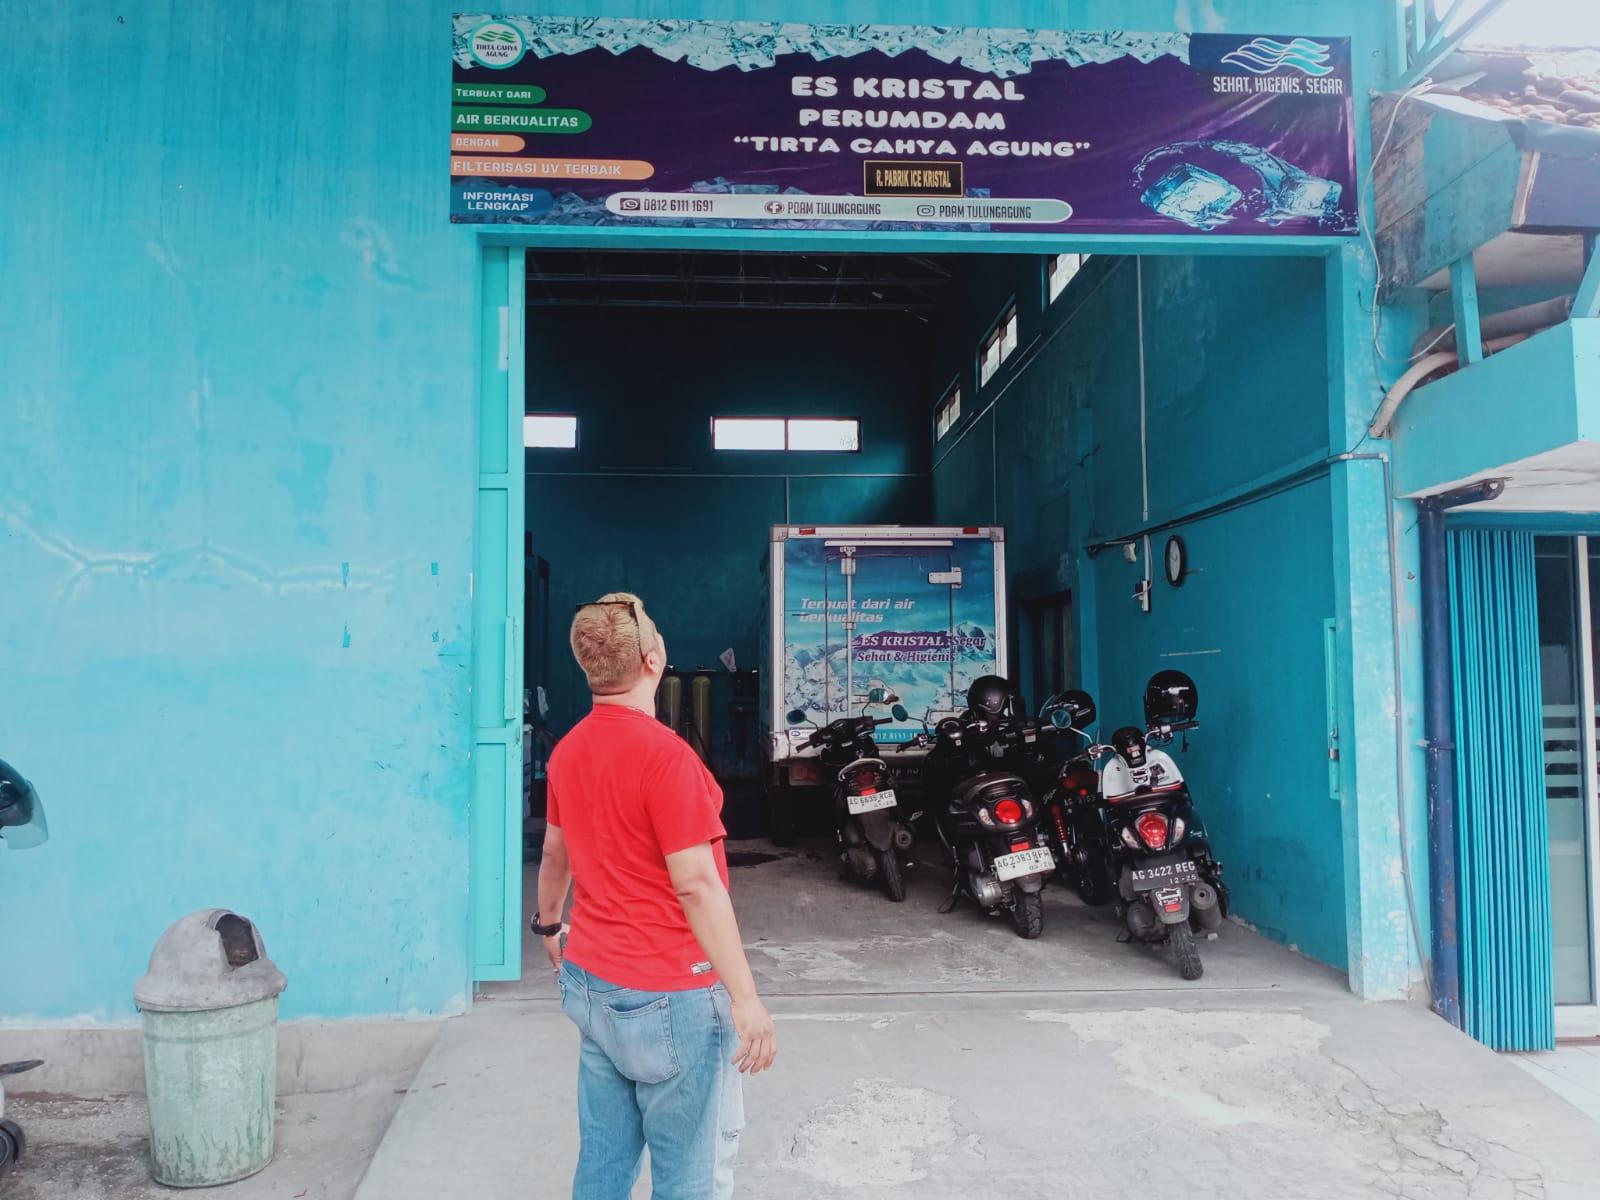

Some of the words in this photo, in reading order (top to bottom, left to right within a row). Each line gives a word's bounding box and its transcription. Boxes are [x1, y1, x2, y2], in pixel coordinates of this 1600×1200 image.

[791, 76, 838, 97] ES
[853, 77, 1025, 101] KRISTAL
[1213, 76, 1252, 94] SEHAT,
[1306, 78, 1343, 95] SEGAR
[456, 88, 502, 98] TERBUAT
[507, 91, 531, 99] DARI
[457, 114, 479, 124] AIR
[484, 115, 579, 127] BERKUALITAS
[799, 109, 1006, 130] PERUMDAM
[456, 138, 499, 147] DENGAN
[850, 138, 957, 155] CAHYA
[453, 161, 537, 173] FILTERISASI
[541, 163, 559, 174] UV
[564, 163, 621, 175] TERBAIK
[876, 169, 883, 187] R.
[884, 169, 909, 187] PABRIK
[911, 170, 922, 188] ICE
[923, 170, 952, 188] KRISTAL
[463, 191, 534, 202] INFORMASI
[467, 202, 529, 211] LENGKAP
[644, 199, 667, 211] 0812
[671, 199, 689, 211] 6111
[692, 200, 713, 212] 1691
[788, 203, 814, 215] PDAM
[816, 203, 881, 215] TULUNGAGUNG
[939, 205, 964, 218] PDAM
[967, 206, 1031, 219] TULUNGAGUNG
[861, 598, 890, 609] dari
[895, 598, 915, 609] air
[861, 636, 879, 646] ES
[882, 636, 944, 646] KRISTAL
[857, 651, 891, 662] Sehat
[894, 652, 904, 662] &
[905, 651, 955, 663] Higienis
[1132, 870, 1145, 881] AG
[1147, 865, 1173, 879] 3422
